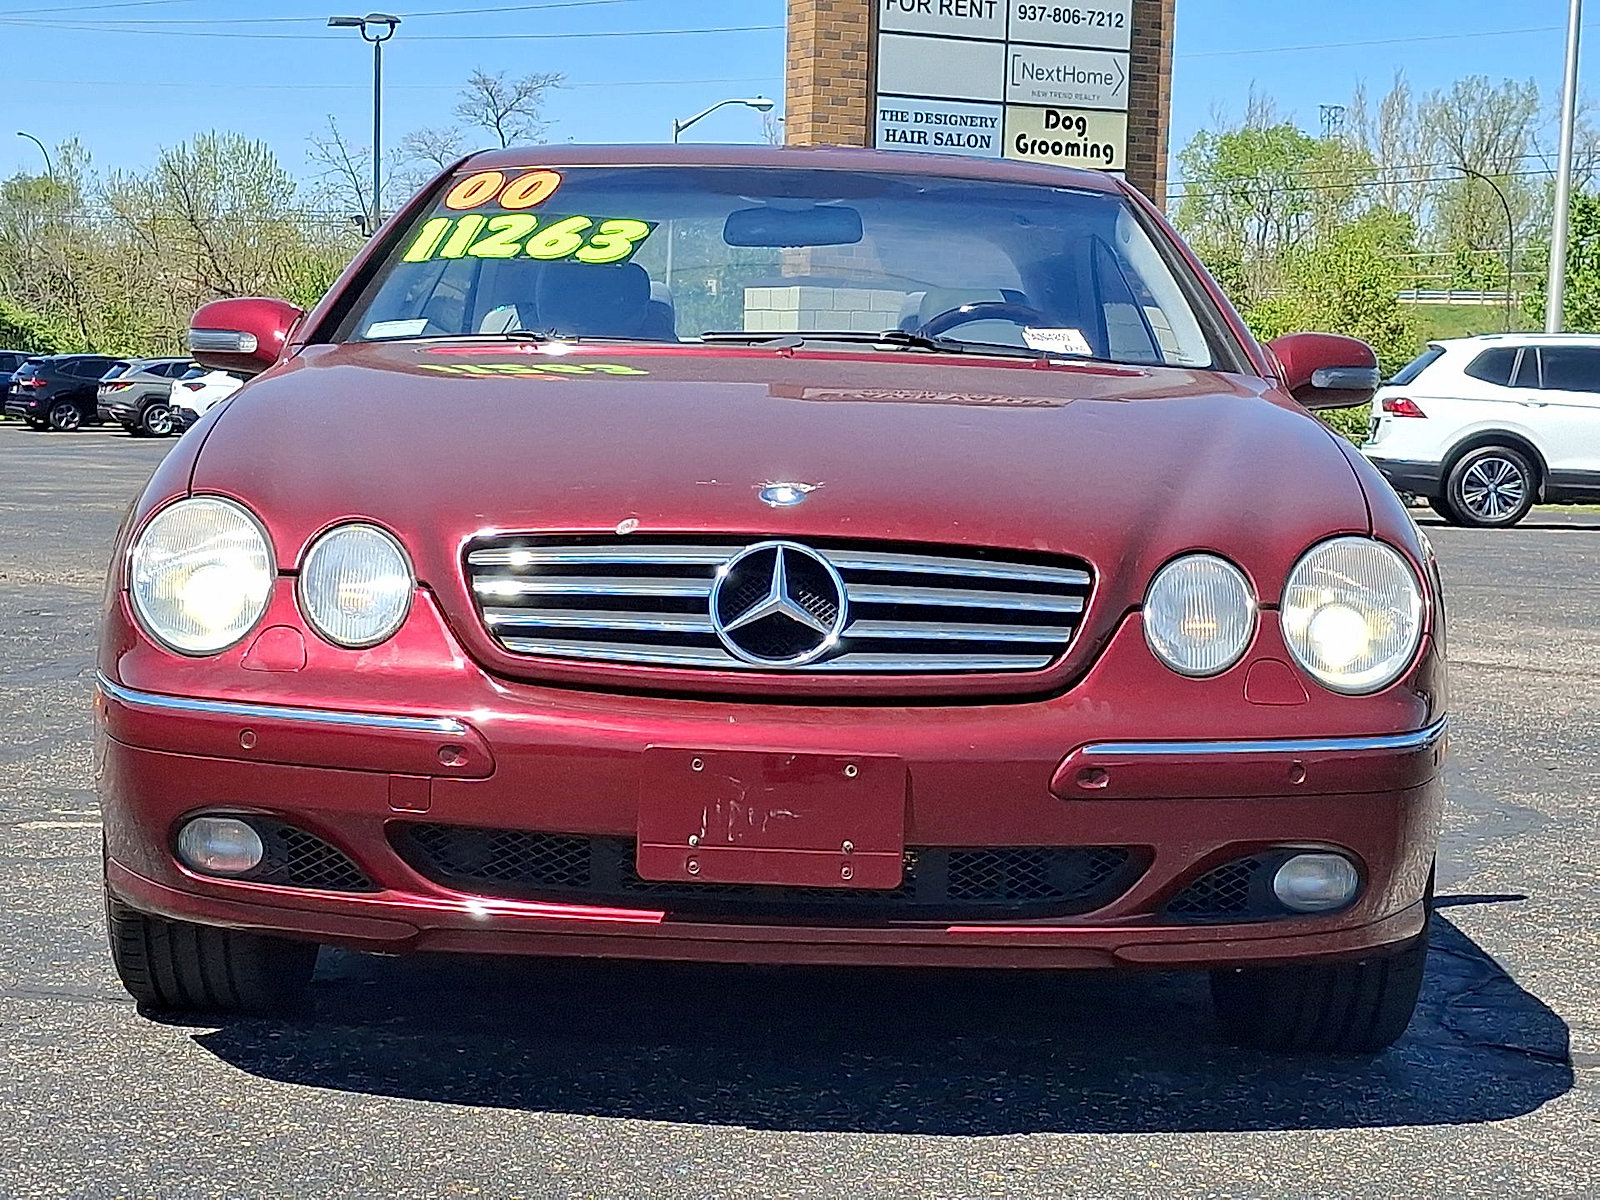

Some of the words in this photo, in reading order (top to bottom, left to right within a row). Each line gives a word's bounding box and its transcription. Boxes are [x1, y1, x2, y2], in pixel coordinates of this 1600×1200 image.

[886, 0, 931, 14] FOR
[939, 0, 998, 19] RENT
[1018, 5, 1124, 28] 937-806-7212
[1022, 62, 1113, 85] NextHome
[1031, 90, 1047, 98] NEW
[1049, 91, 1073, 100] TREND
[1074, 93, 1101, 101] REALTY
[880, 110, 909, 121] THE
[913, 112, 998, 128] DESIGNERY
[1045, 109, 1087, 137] Dog
[884, 129, 929, 145] HAIR
[933, 132, 992, 149] SALON
[1015, 133, 1114, 164] Grooming
[445, 170, 562, 210] 00
[402, 213, 651, 264] 11263
